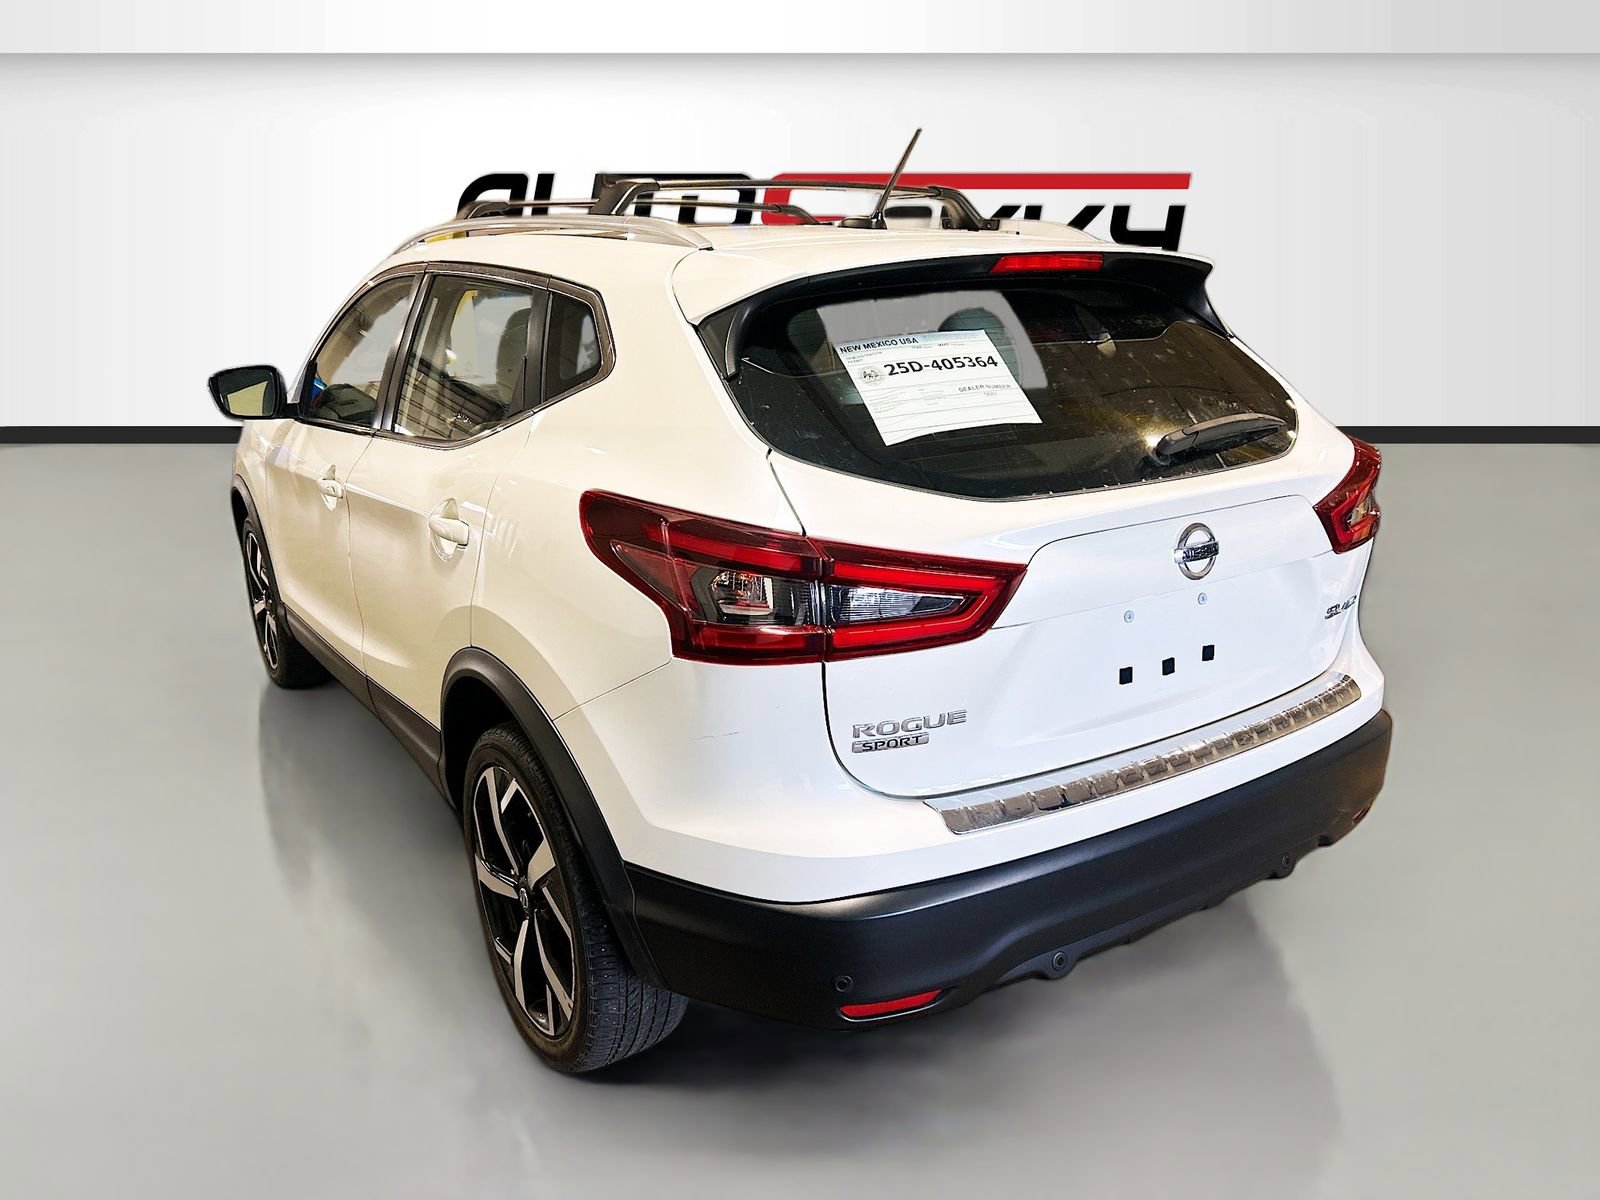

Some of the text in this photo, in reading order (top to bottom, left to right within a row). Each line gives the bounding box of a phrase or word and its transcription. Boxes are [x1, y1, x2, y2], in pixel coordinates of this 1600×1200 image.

[839, 337, 919, 354] NEW MEXICO USA
[884, 355, 998, 376] 25D-405364
[852, 709, 967, 739] ROGUE
[862, 735, 923, 752] SPORT
